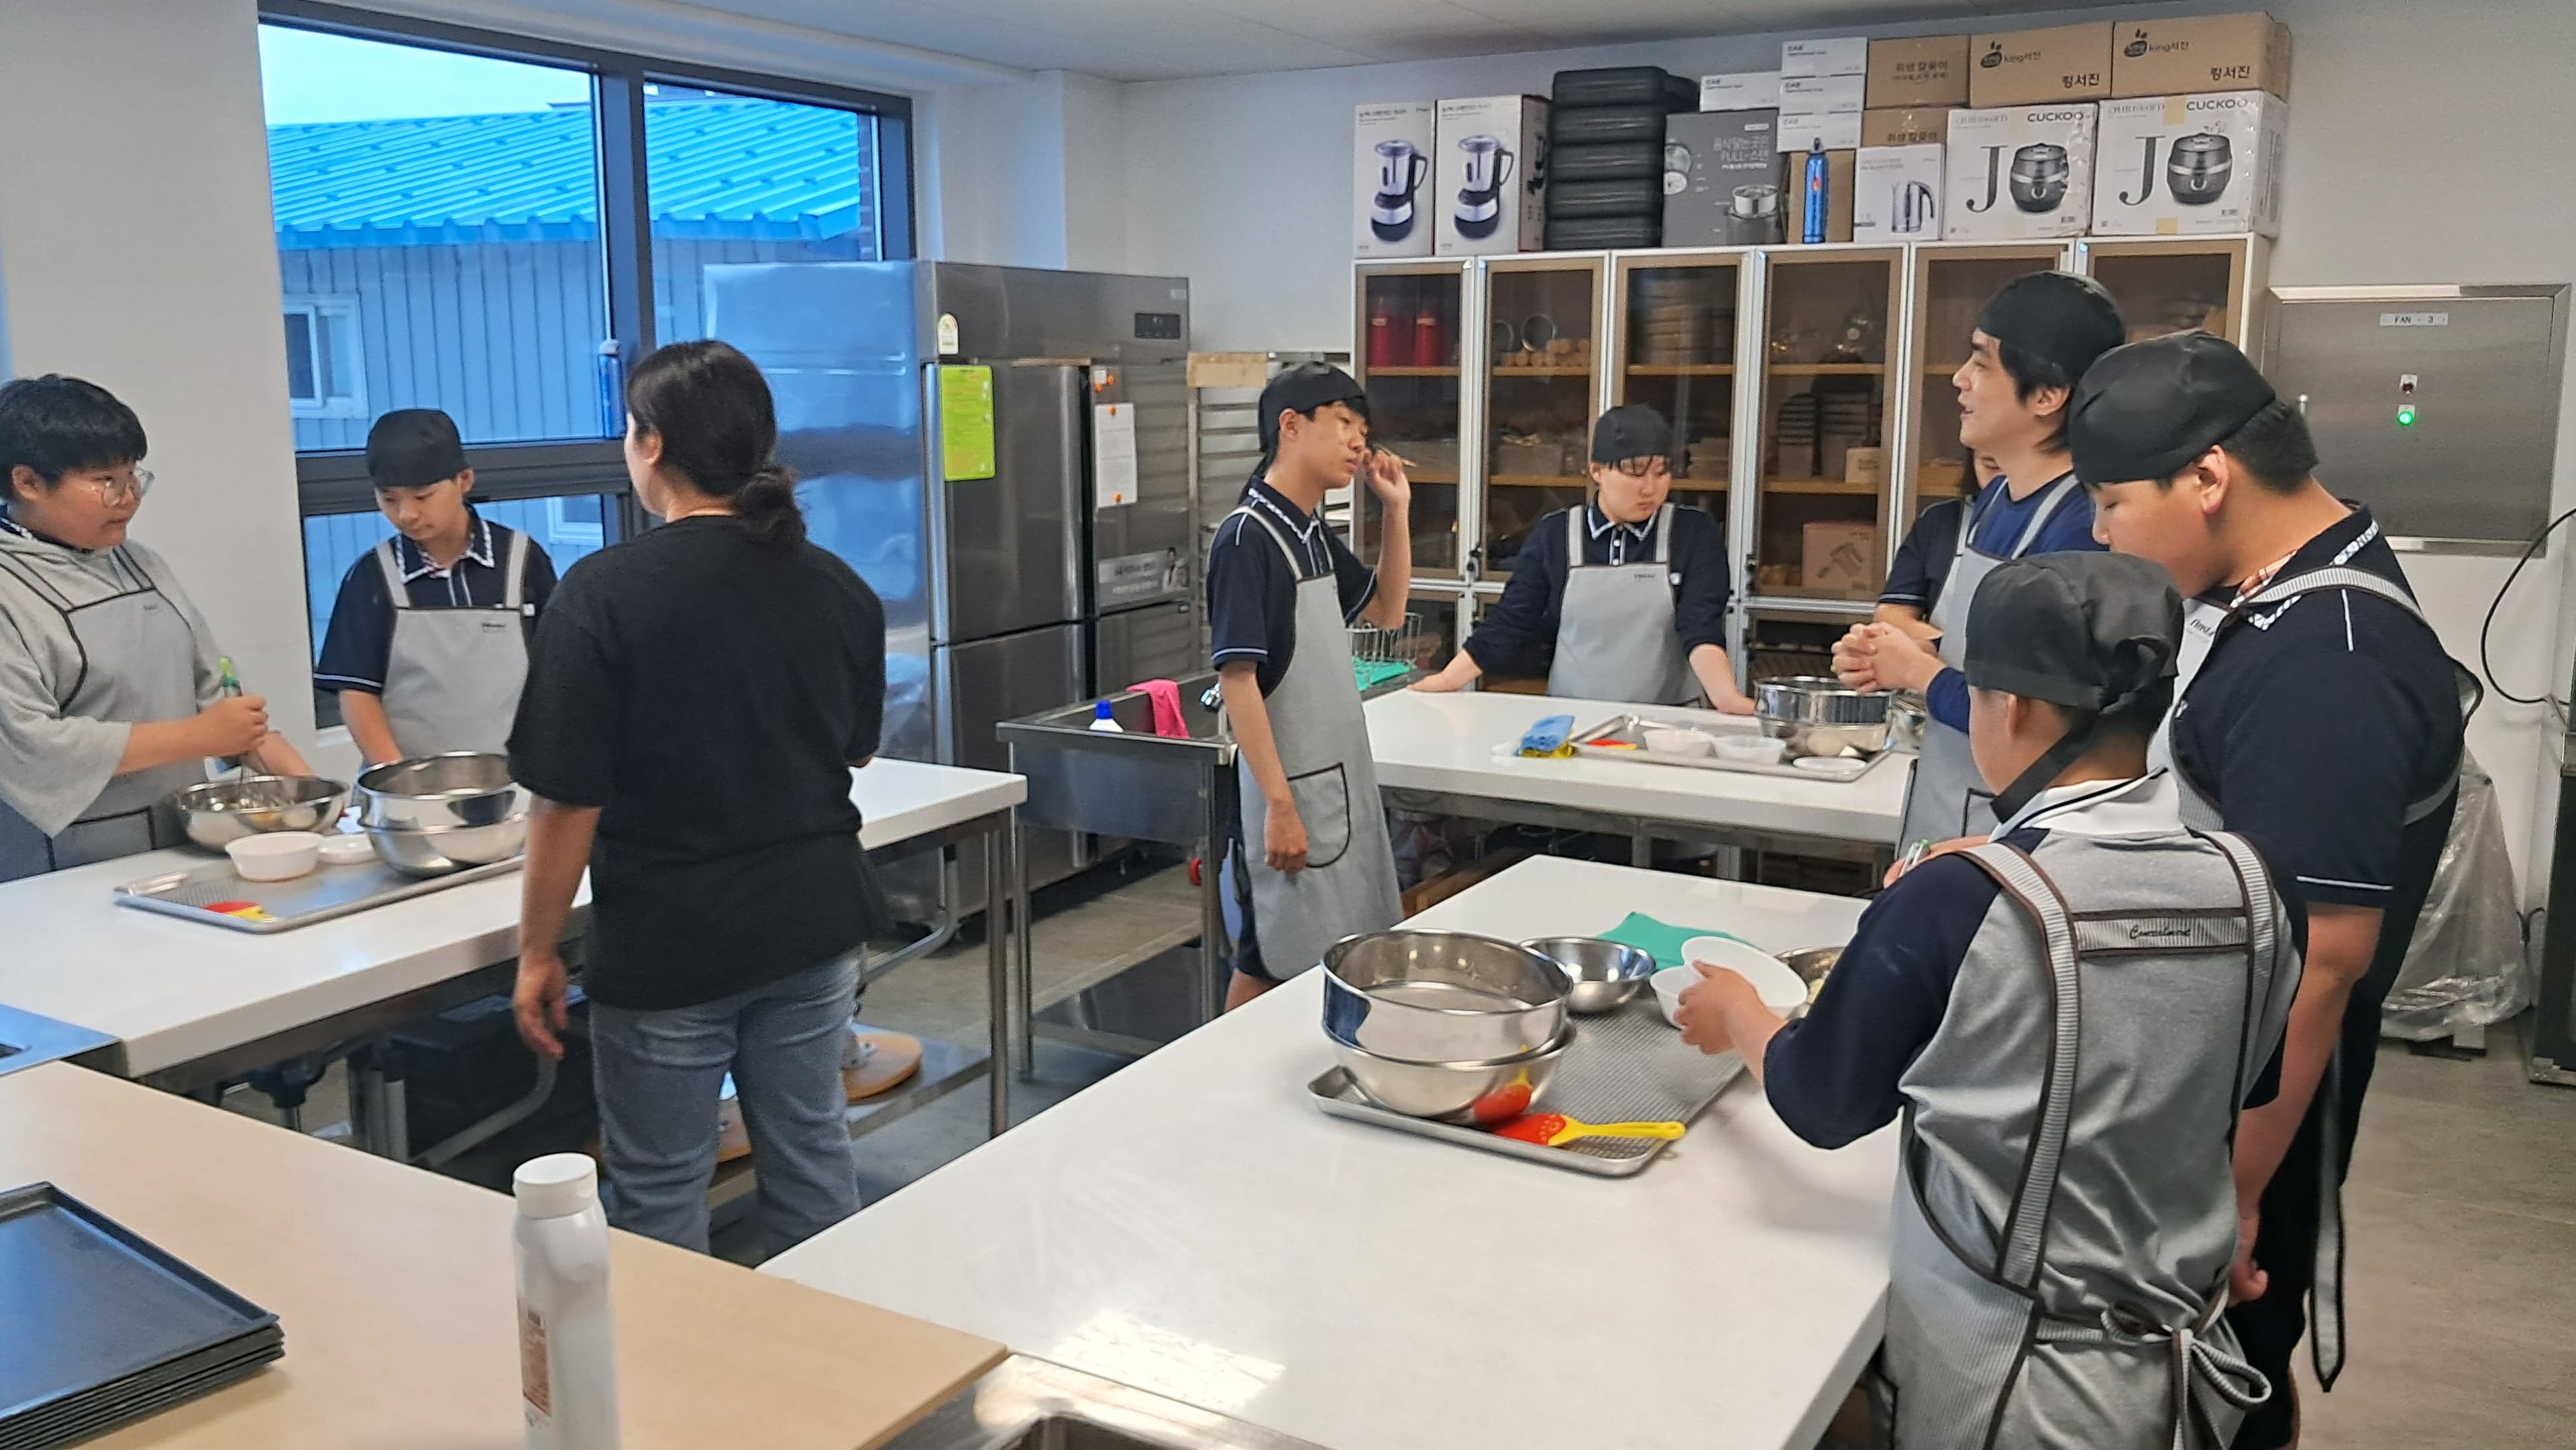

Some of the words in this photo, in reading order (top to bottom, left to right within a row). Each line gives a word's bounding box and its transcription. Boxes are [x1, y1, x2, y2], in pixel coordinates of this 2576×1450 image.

[2062, 73, 2100, 89] 킹서진
[2210, 66, 2251, 81] 킹서진
[2186, 99, 2249, 111] CUCKOO
[2027, 111, 2084, 123] CUCKOO
[2118, 136, 2166, 206] J
[1966, 145, 2008, 213] J
